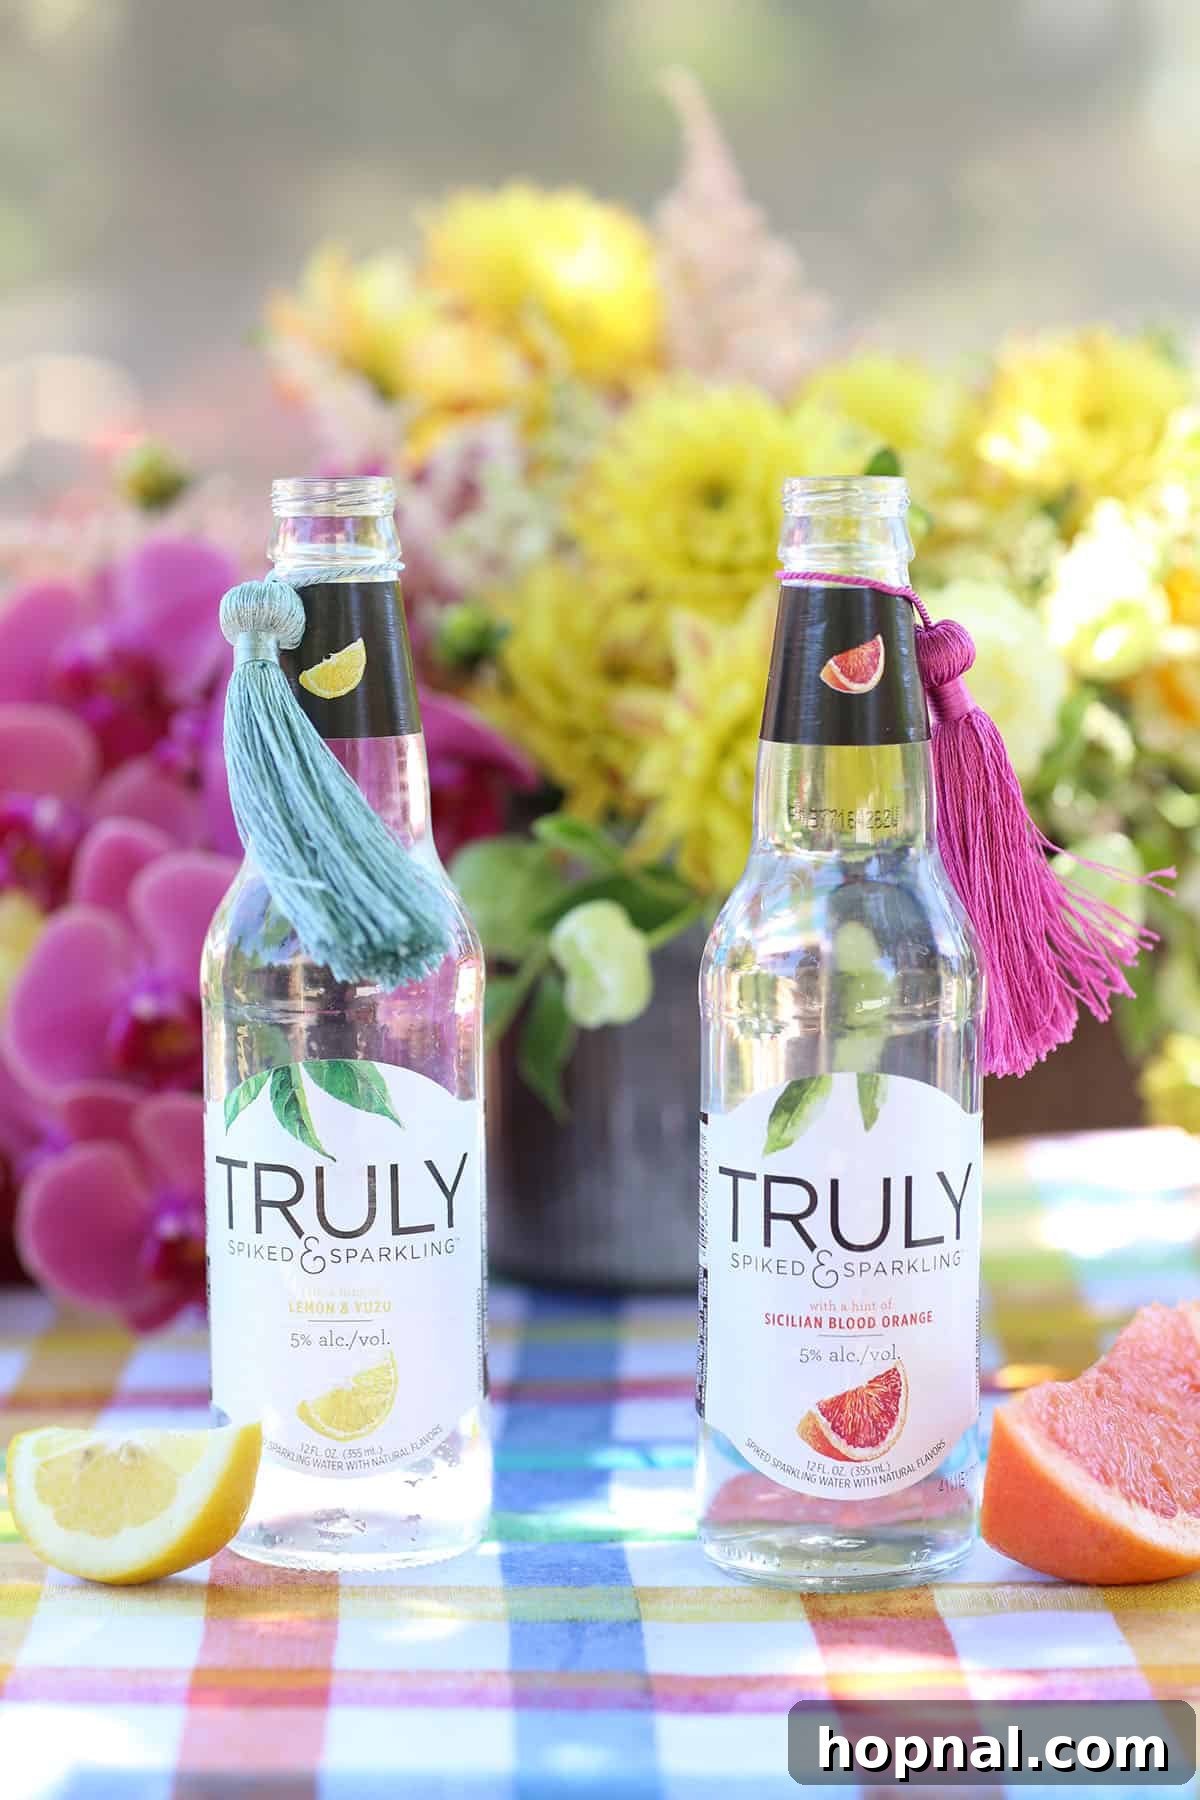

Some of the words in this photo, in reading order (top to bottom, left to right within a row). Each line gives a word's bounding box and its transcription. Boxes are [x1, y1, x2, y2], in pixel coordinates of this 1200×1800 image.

[216, 1152, 468, 1239] TRULY
[719, 1162, 973, 1252] TRULY
[228, 1239, 294, 1262] SPIKED
[300, 1236, 326, 1275] &
[330, 1238, 456, 1264] SPARKLING
[730, 1252, 805, 1277] SPIKED
[812, 1249, 839, 1289] &
[843, 1250, 961, 1279] SPARKLING
[288, 1300, 335, 1313] LEMON
[340, 1300, 349, 1314] &
[354, 1300, 392, 1313] YUZU
[810, 1299, 836, 1312] with
[840, 1303, 847, 1312] a
[850, 1299, 876, 1312] hint
[880, 1297, 893, 1311] of
[764, 1312, 822, 1329] SICILIAN
[828, 1316, 876, 1330] BLOOD
[882, 1310, 933, 1328] ORANGE
[290, 1332, 312, 1348] 5%
[319, 1328, 391, 1351] alc./vol.
[799, 1347, 822, 1363] 5%
[829, 1343, 901, 1365] alc./vol.
[268, 1440, 311, 1467] SPARKLING
[312, 1457, 344, 1471] WATER
[345, 1458, 370, 1471] WITH
[371, 1447, 410, 1468] NATURAL
[410, 1424, 443, 1455] FLAVORS
[300, 1442, 309, 1454] 12
[744, 1438, 772, 1463] SPIKED
[772, 1458, 817, 1484] SPARKLING
[819, 1476, 851, 1489] WATER
[853, 1476, 878, 1489] WITH
[879, 1464, 916, 1484] NATURAL
[916, 1439, 946, 1469] FLAVORS
[805, 1460, 816, 1471] 12
[850, 1465, 871, 1478] (355
